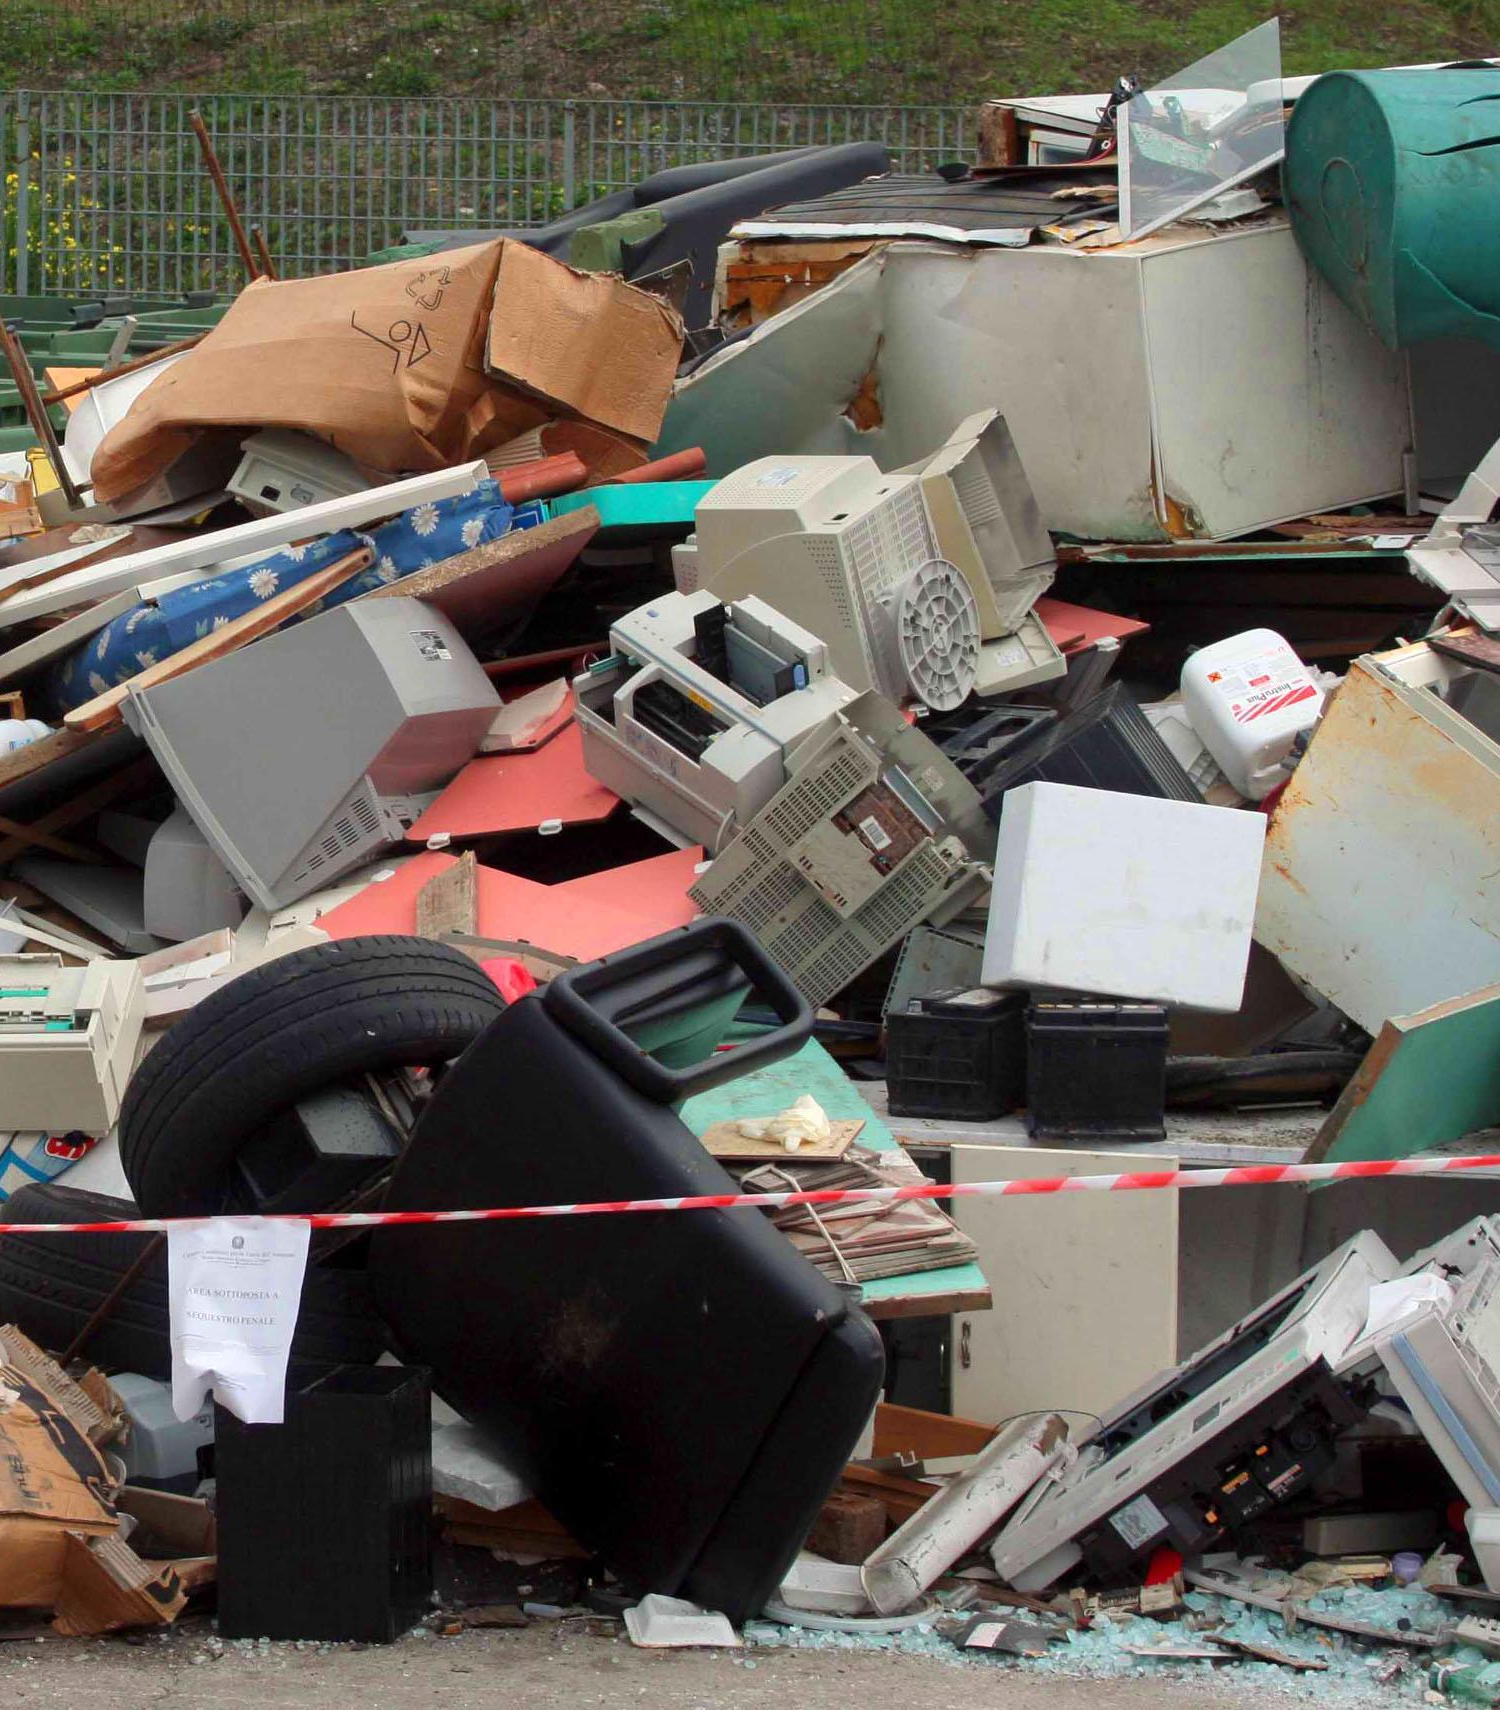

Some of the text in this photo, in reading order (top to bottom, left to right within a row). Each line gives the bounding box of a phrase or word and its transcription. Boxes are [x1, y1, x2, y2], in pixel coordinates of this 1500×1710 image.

[188, 1287, 212, 1297] AREA
[214, 1289, 270, 1299] SOTTOPOSTA
[187, 1311, 276, 1326] SEQUESTRO PENALE
